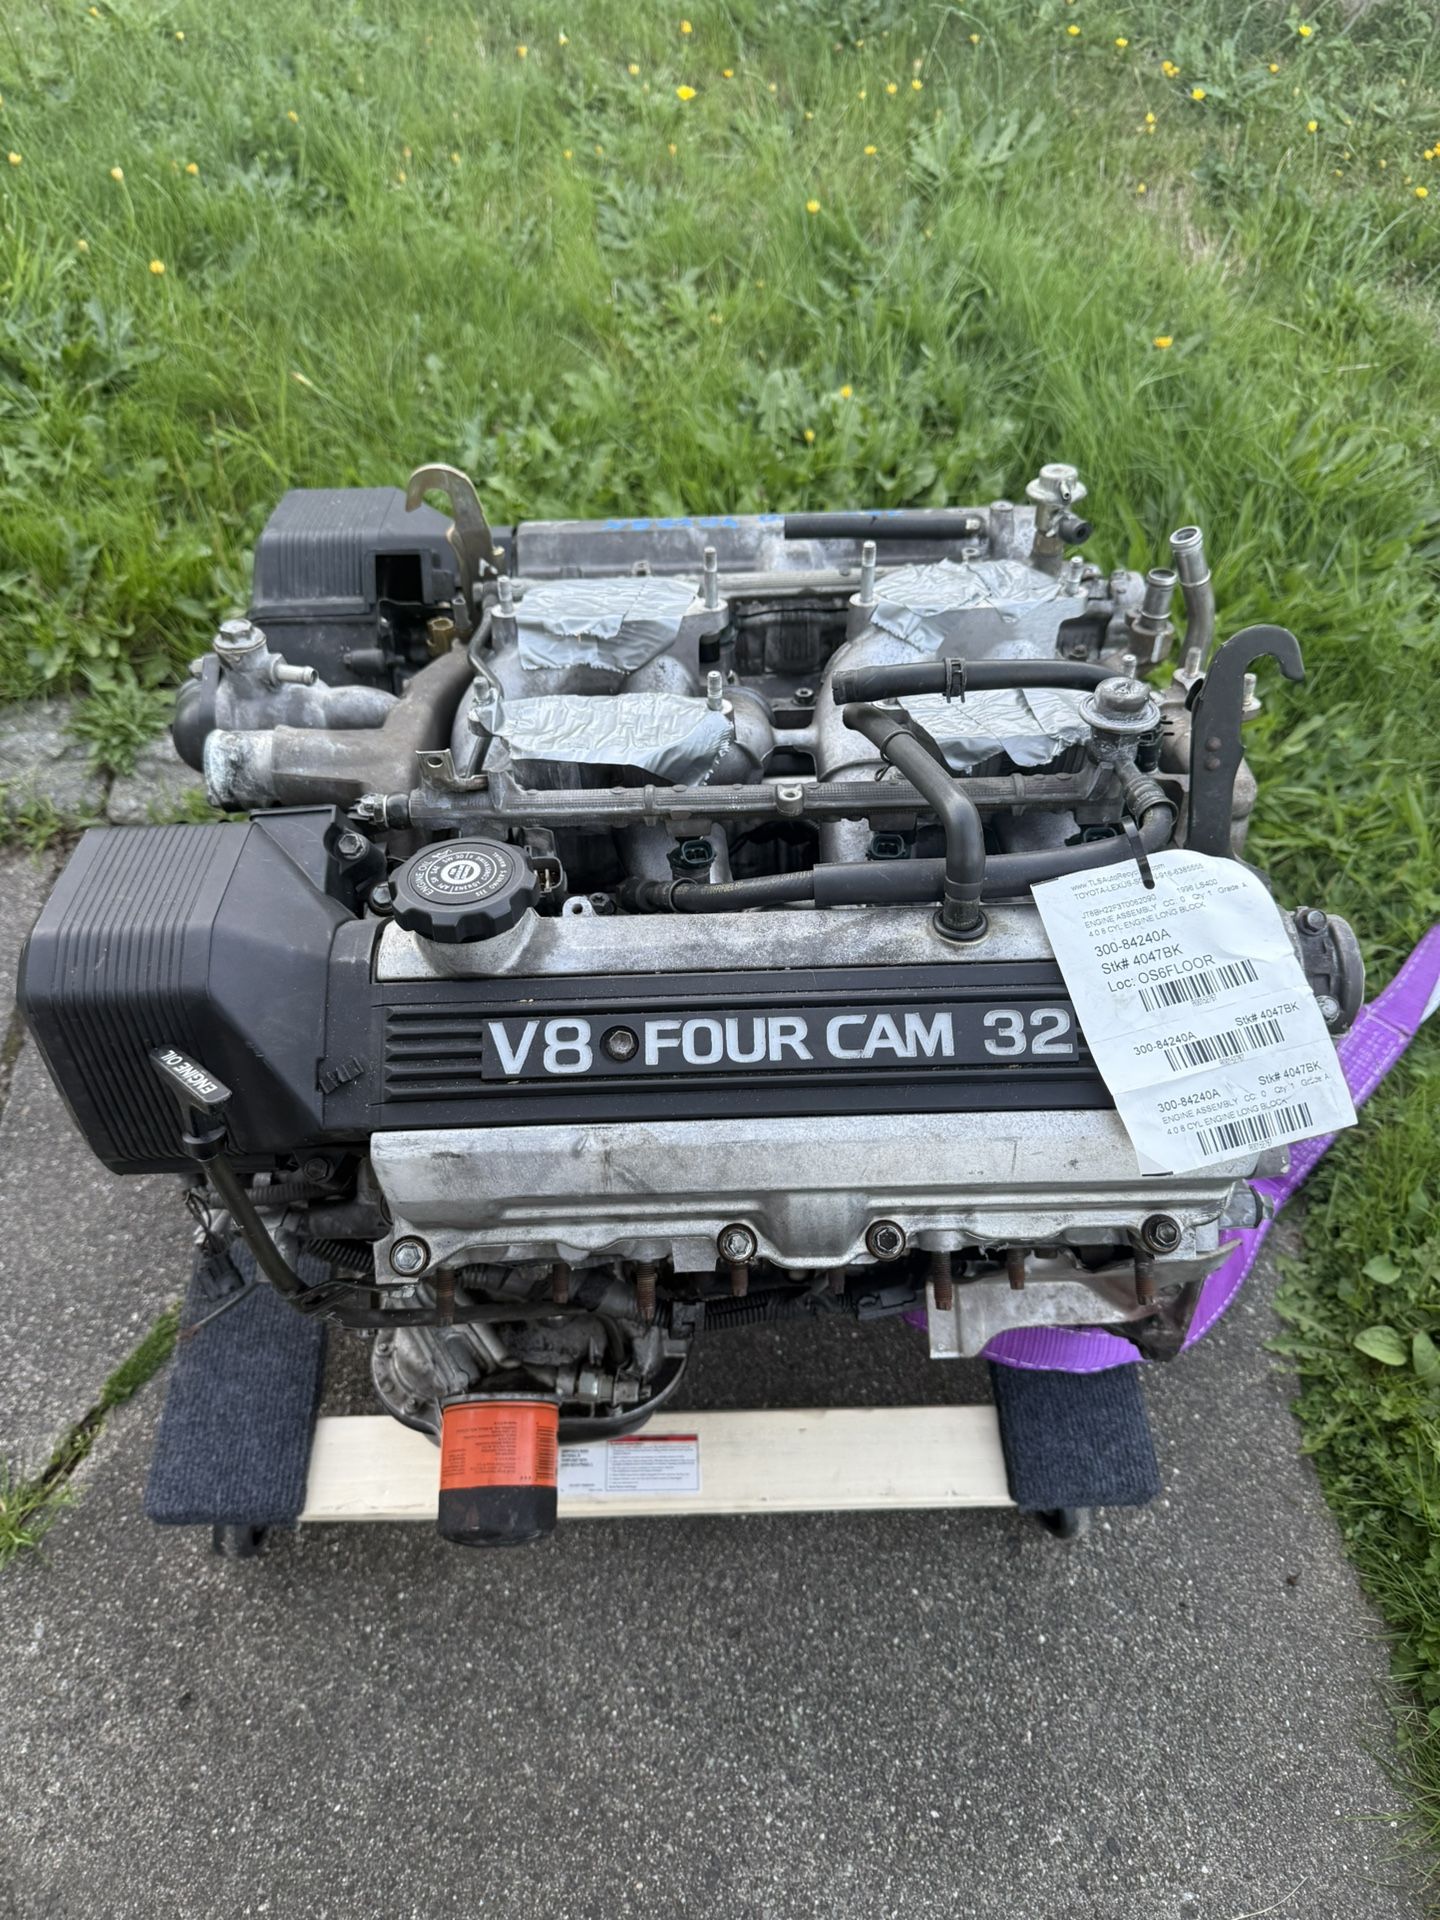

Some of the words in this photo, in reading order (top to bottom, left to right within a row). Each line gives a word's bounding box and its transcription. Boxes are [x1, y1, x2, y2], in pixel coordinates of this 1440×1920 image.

[418, 860, 432, 872] OIL
[416, 872, 434, 896] ENGINE
[1195, 879, 1218, 890] LS400
[1085, 915, 1114, 929] ENGINE
[1116, 904, 1158, 921] ASSEMBLY
[1218, 884, 1239, 894] Grade
[1124, 914, 1154, 930] ENGINE
[1155, 908, 1178, 920] LONG
[1178, 902, 1206, 914] BLOCK
[1094, 928, 1172, 957] 300-84240A
[1101, 958, 1130, 974] Stk#
[1133, 944, 1184, 966] 4047BK
[1107, 977, 1136, 992] Loc:
[1138, 954, 1216, 984] OS6FLOOR
[488, 1018, 593, 1075] V8
[643, 1016, 813, 1066] FOUR
[826, 1012, 955, 1060] CAM
[982, 1008, 1073, 1056] 32
[1133, 1030, 1197, 1056] 300-84240A
[1234, 1013, 1258, 1026] Stk#
[1260, 1002, 1300, 1019] 4047BK
[160, 1049, 183, 1065] OIL
[172, 1062, 218, 1094] ENGINE
[1157, 1088, 1221, 1113] 300-84240A
[1258, 1072, 1281, 1086] Stk#
[1283, 1060, 1322, 1080] 4047BK
[1162, 1110, 1196, 1124] ENGINE
[1196, 1098, 1238, 1116] ASSEMBLY
[1186, 1120, 1204, 1130] CYL
[1205, 1112, 1236, 1126] ENGINE
[1237, 1105, 1260, 1118] LONG
[1260, 1098, 1288, 1110] BLOCK
